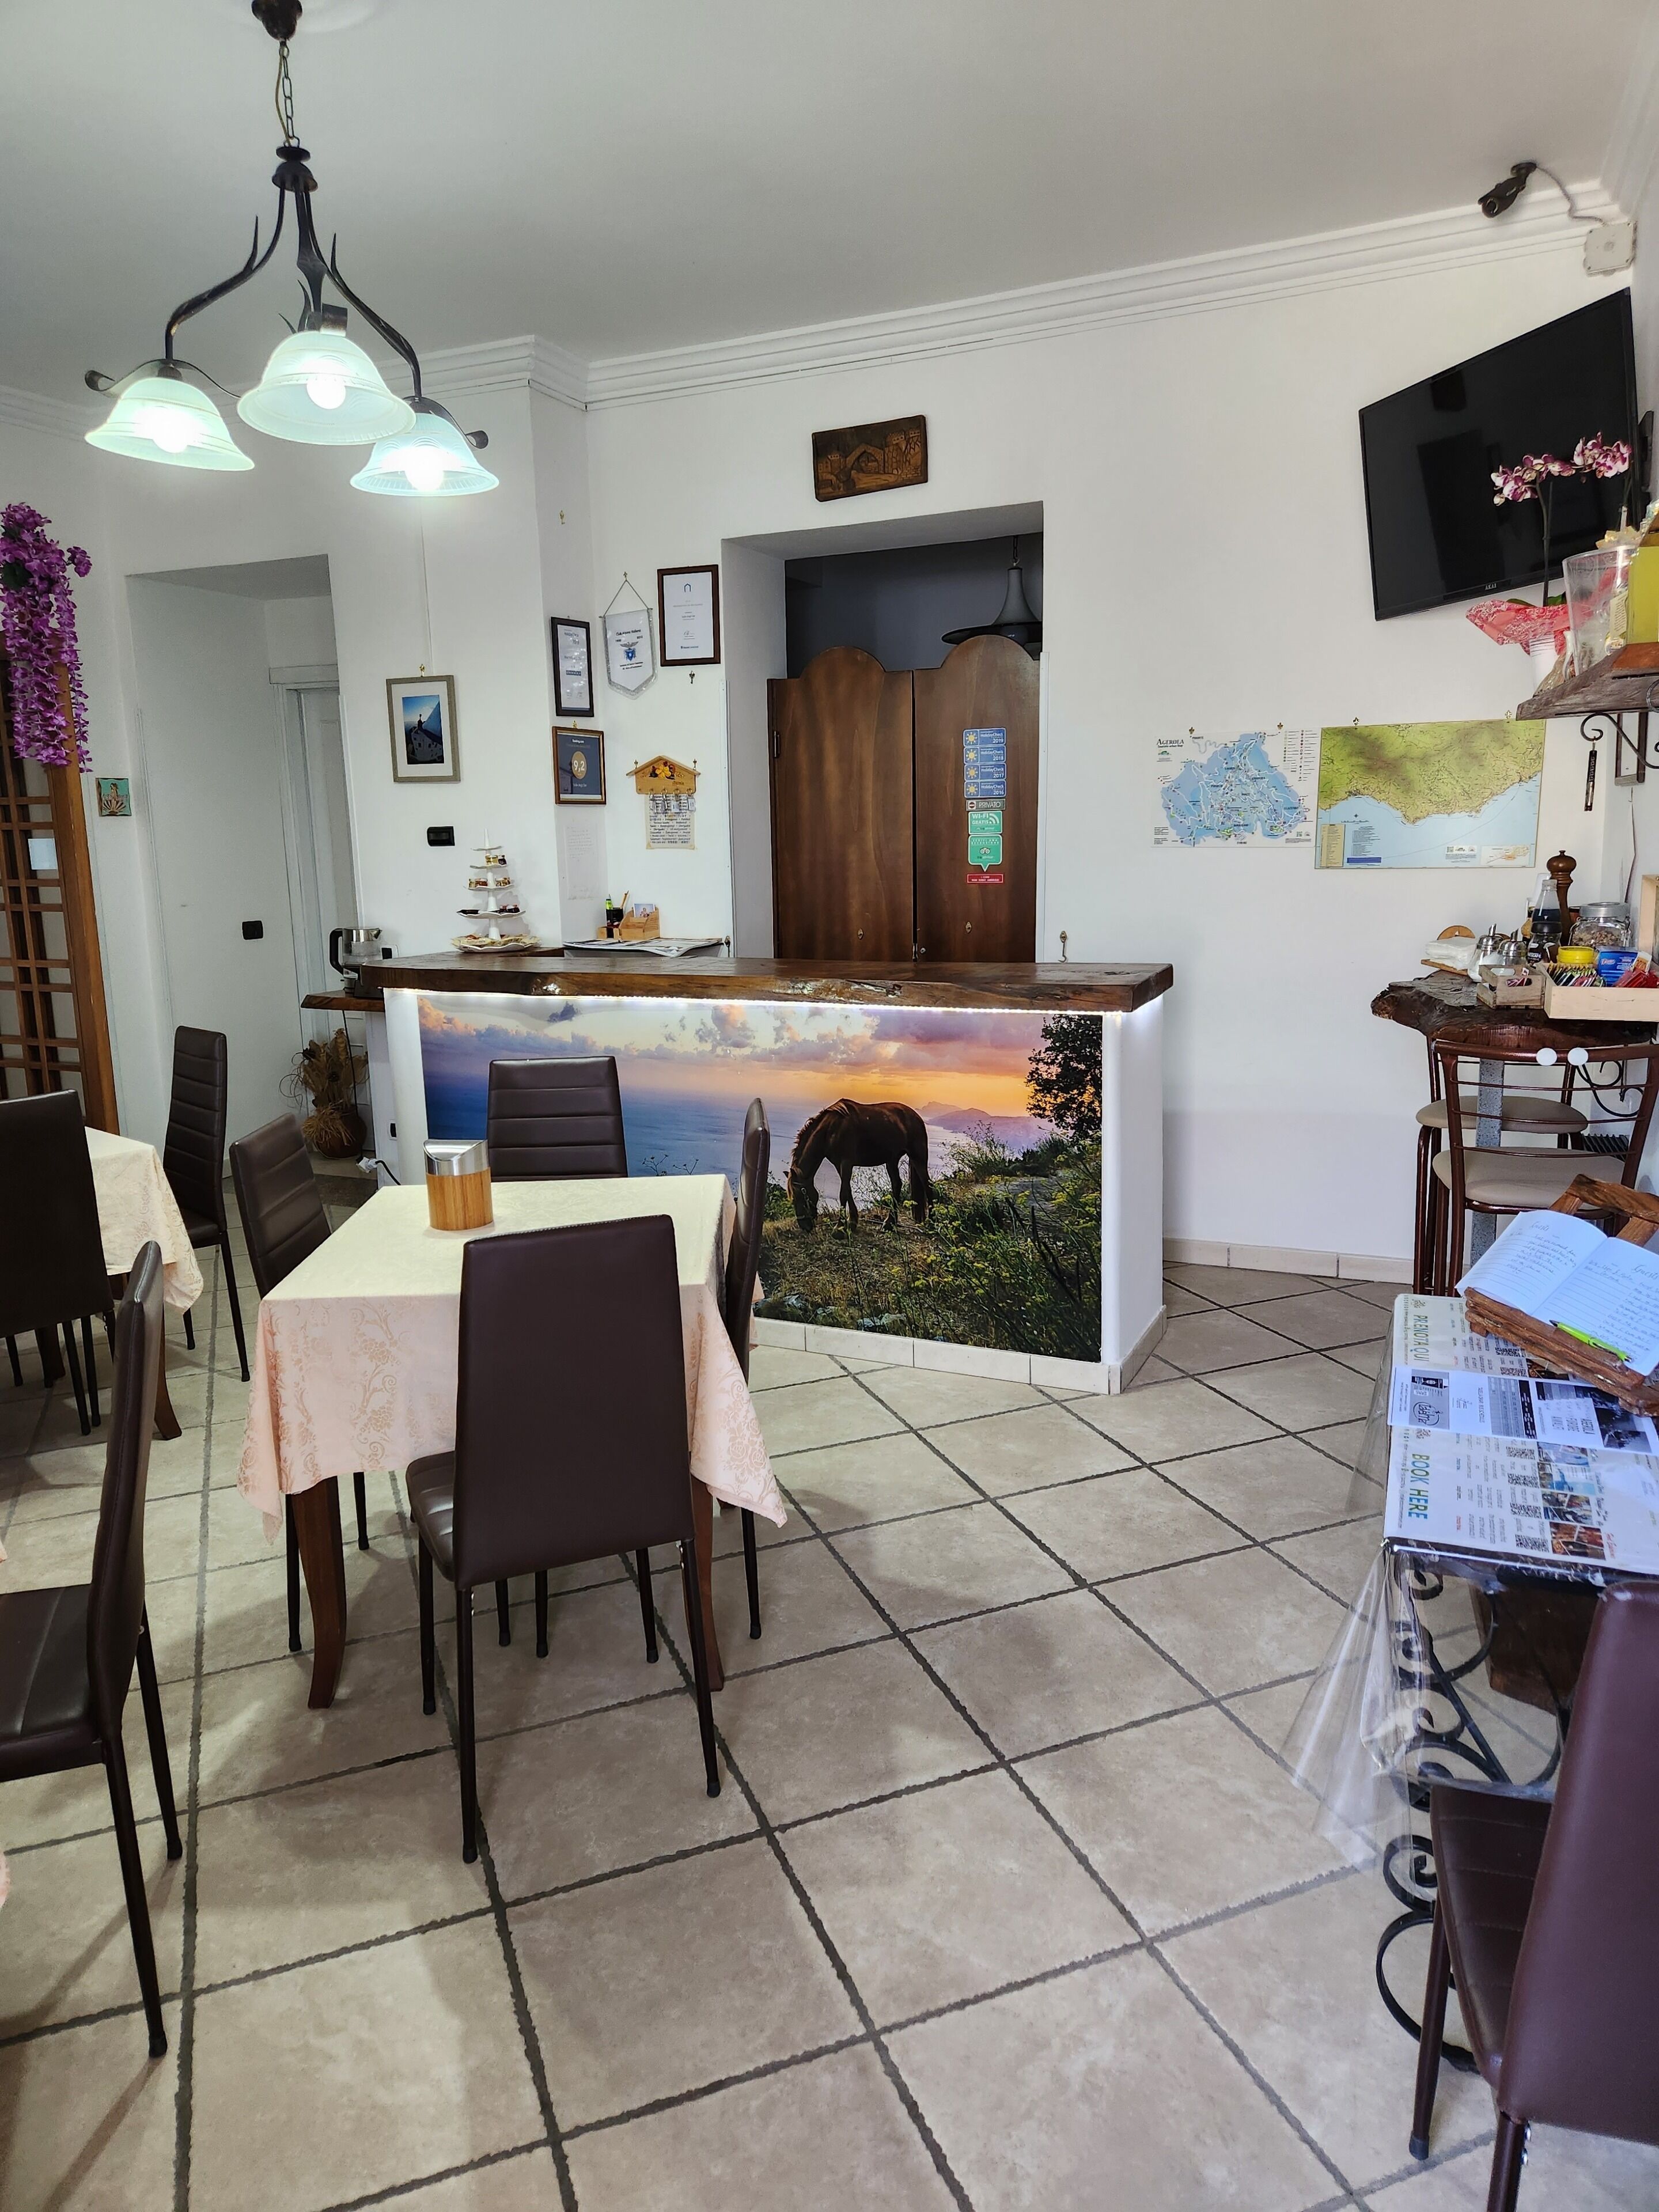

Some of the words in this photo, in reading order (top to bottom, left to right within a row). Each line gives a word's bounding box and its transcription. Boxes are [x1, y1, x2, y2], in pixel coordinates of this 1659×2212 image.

[574, 760, 585, 772] 9,2
[1413, 1315, 1430, 1346] PRENOTA
[1410, 1347, 1430, 1362] QUI
[1410, 1454, 1431, 1484] BOOK
[1408, 1488, 1429, 1520] HERE
